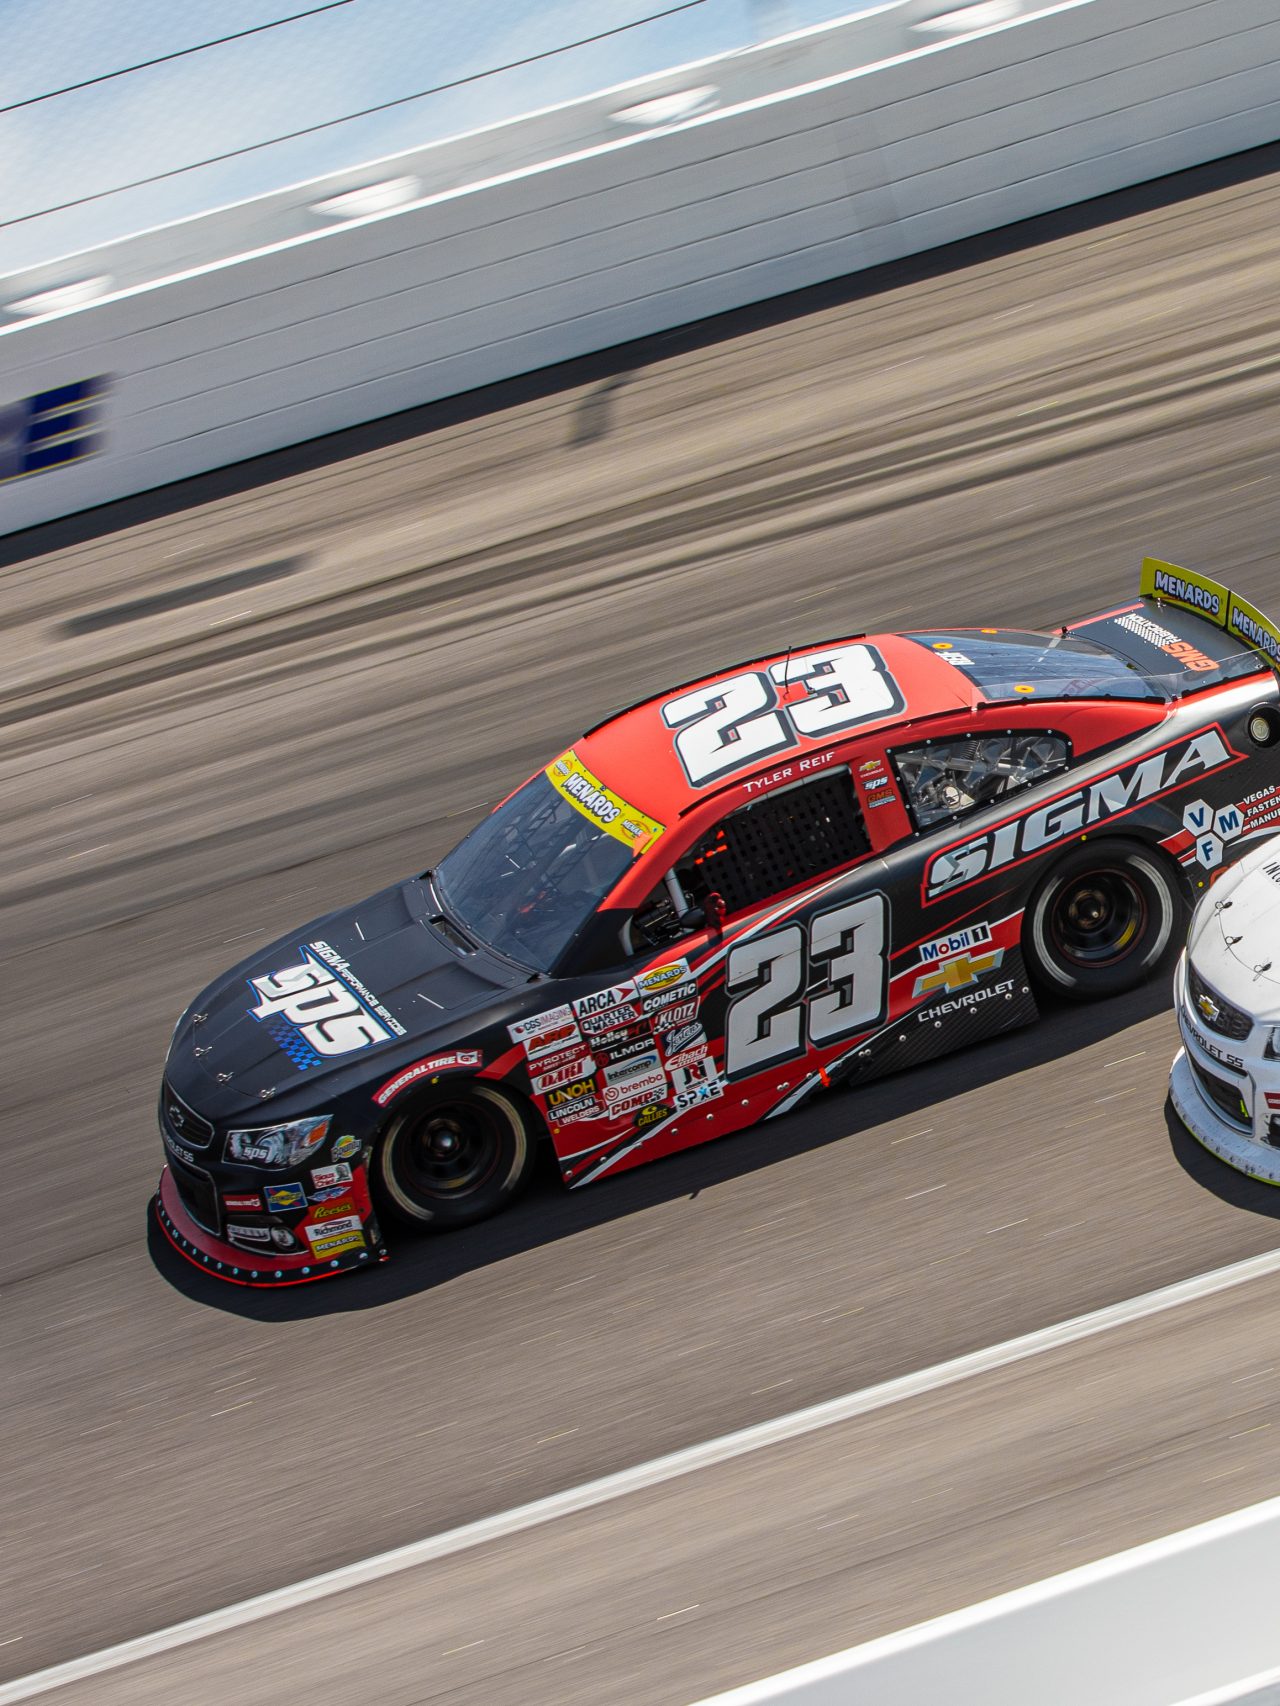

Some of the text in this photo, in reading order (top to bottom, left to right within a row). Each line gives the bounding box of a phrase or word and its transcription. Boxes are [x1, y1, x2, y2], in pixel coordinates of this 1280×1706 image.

[1154, 570, 1221, 615] MENARDS
[660, 644, 905, 788] 23
[743, 752, 836, 792] TYLER REIF
[561, 772, 621, 824] MENARDS
[1243, 785, 1277, 805] VEGAS
[928, 730, 1231, 896] SIGMA
[1188, 807, 1205, 828] V
[1218, 810, 1240, 834] M
[1201, 840, 1213, 862] F
[922, 932, 970, 960] Mobil
[638, 965, 688, 990] MENARDS
[726, 893, 888, 1080] 23
[579, 990, 617, 1017] ARCA
[643, 983, 697, 1011] COMETIC
[918, 979, 1015, 1022] CHEVROLET
[582, 1005, 632, 1031] QUARTER
[592, 1011, 637, 1033] MASTER
[659, 1002, 696, 1026] KLOTZ
[528, 1024, 577, 1052] ARP
[590, 1028, 629, 1048] Holley
[610, 1038, 656, 1060] ILMOR
[528, 1045, 587, 1070] PYROTECT
[607, 1060, 652, 1080] Intercomp
[1226, 1054, 1244, 1068] SS
[378, 1065, 428, 1104] GENERAL
[426, 1056, 456, 1070] TIRE
[548, 1078, 597, 1106] UNOH
[620, 1073, 663, 1094] brembo
[549, 1098, 594, 1120] LINCOLN
[562, 1105, 600, 1124] WELDERS
[611, 1091, 654, 1116] COMP
[638, 1107, 669, 1127] CALLIES
